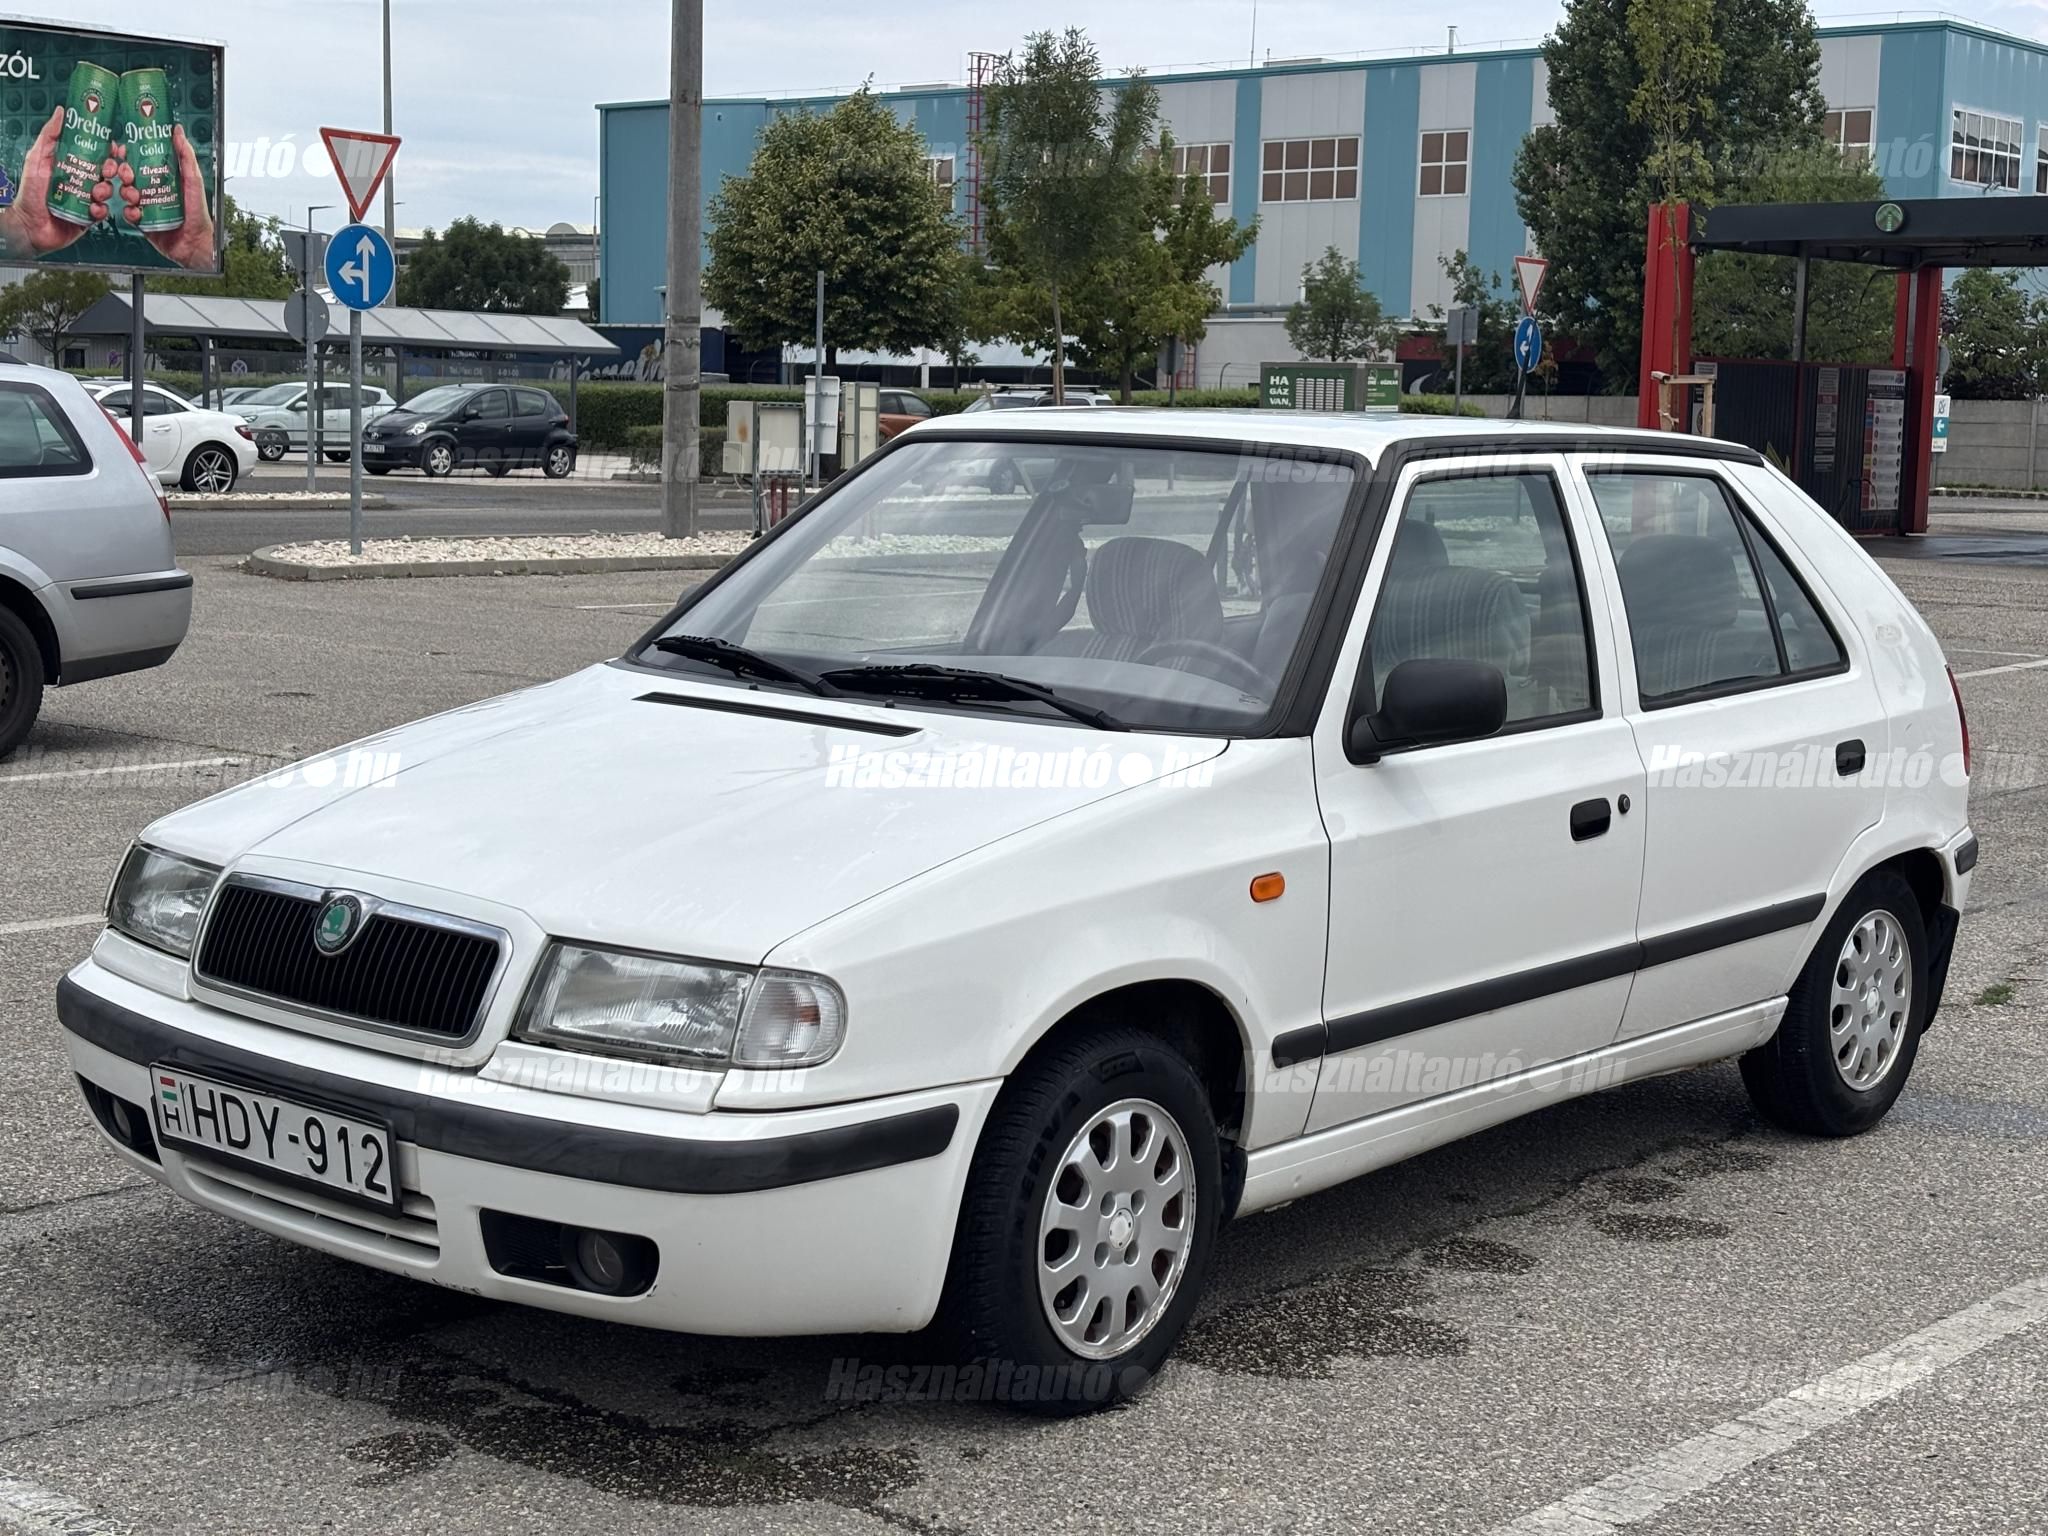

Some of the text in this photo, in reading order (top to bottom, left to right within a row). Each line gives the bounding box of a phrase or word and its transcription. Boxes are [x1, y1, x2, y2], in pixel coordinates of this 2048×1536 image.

[65, 107, 112, 141] Dreher
[125, 120, 173, 144] Dreher
[74, 134, 98, 152] Gold
[140, 142, 165, 156] Gold
[1269, 375, 1289, 386] HA
[1269, 385, 1289, 396] GÁZ
[163, 1083, 387, 1195] H HDY-912
